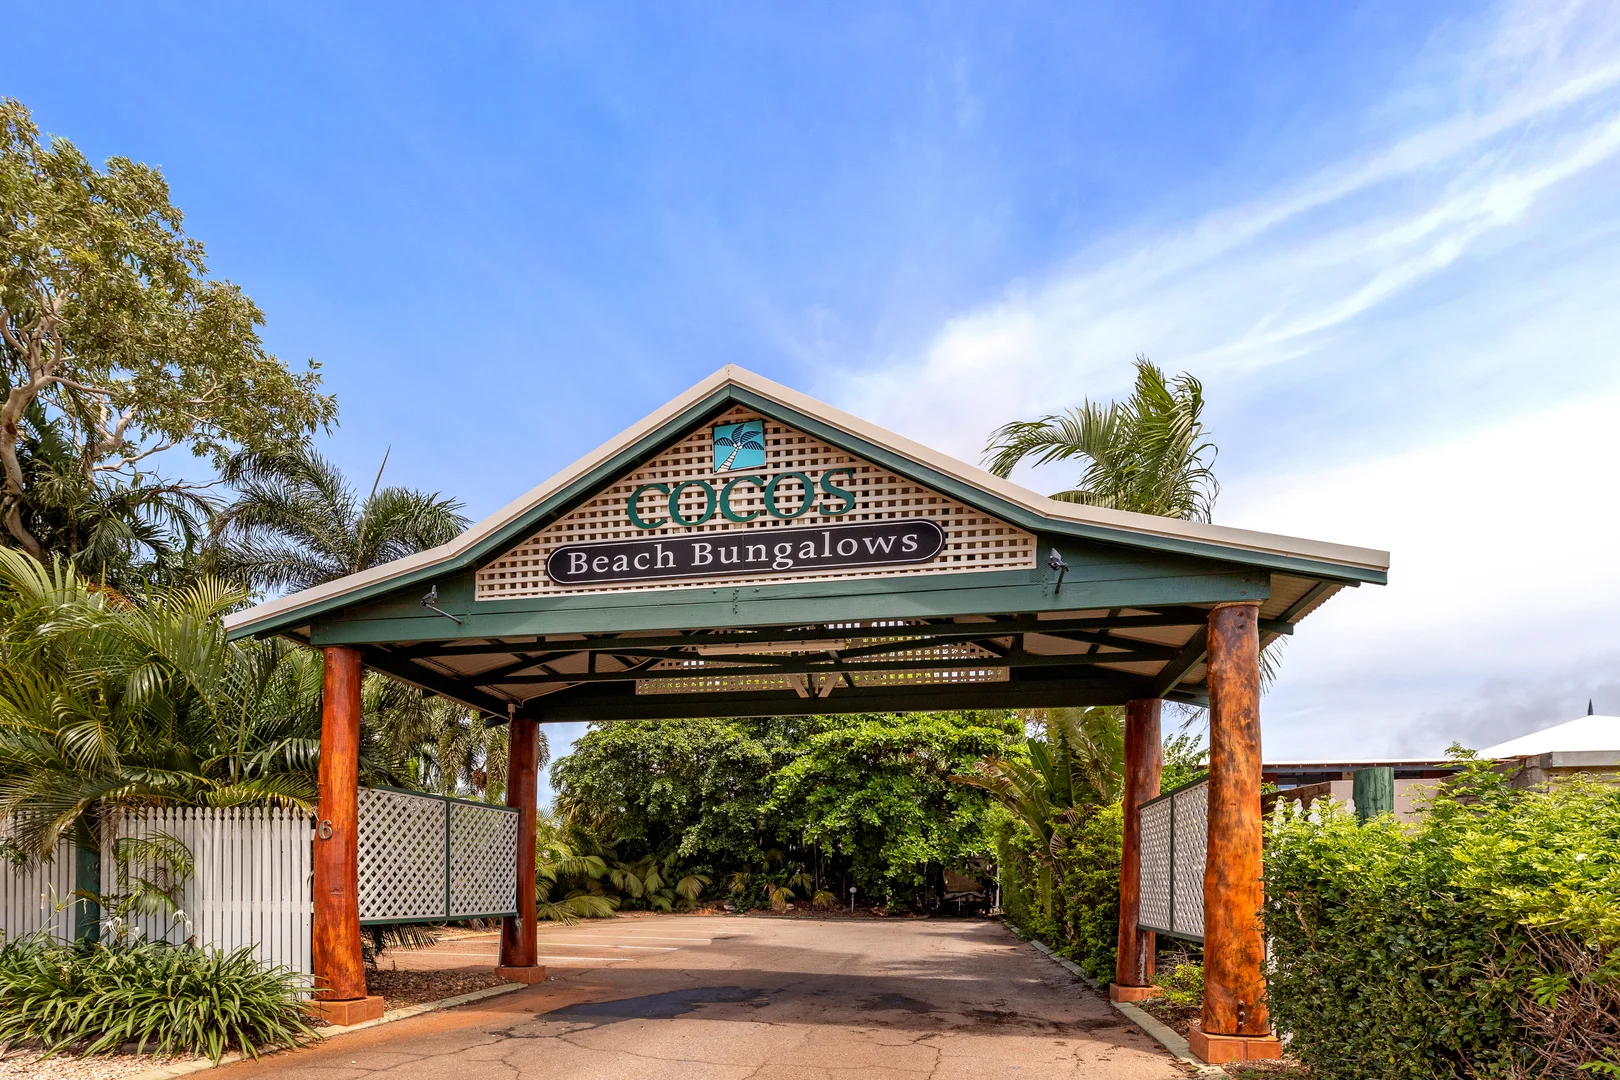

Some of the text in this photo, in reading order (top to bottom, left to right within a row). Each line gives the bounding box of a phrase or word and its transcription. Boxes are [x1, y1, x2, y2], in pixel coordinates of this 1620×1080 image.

[627, 468, 856, 529] COCOS
[567, 531, 918, 575] Beach Bungalows
[319, 819, 333, 840] 6
